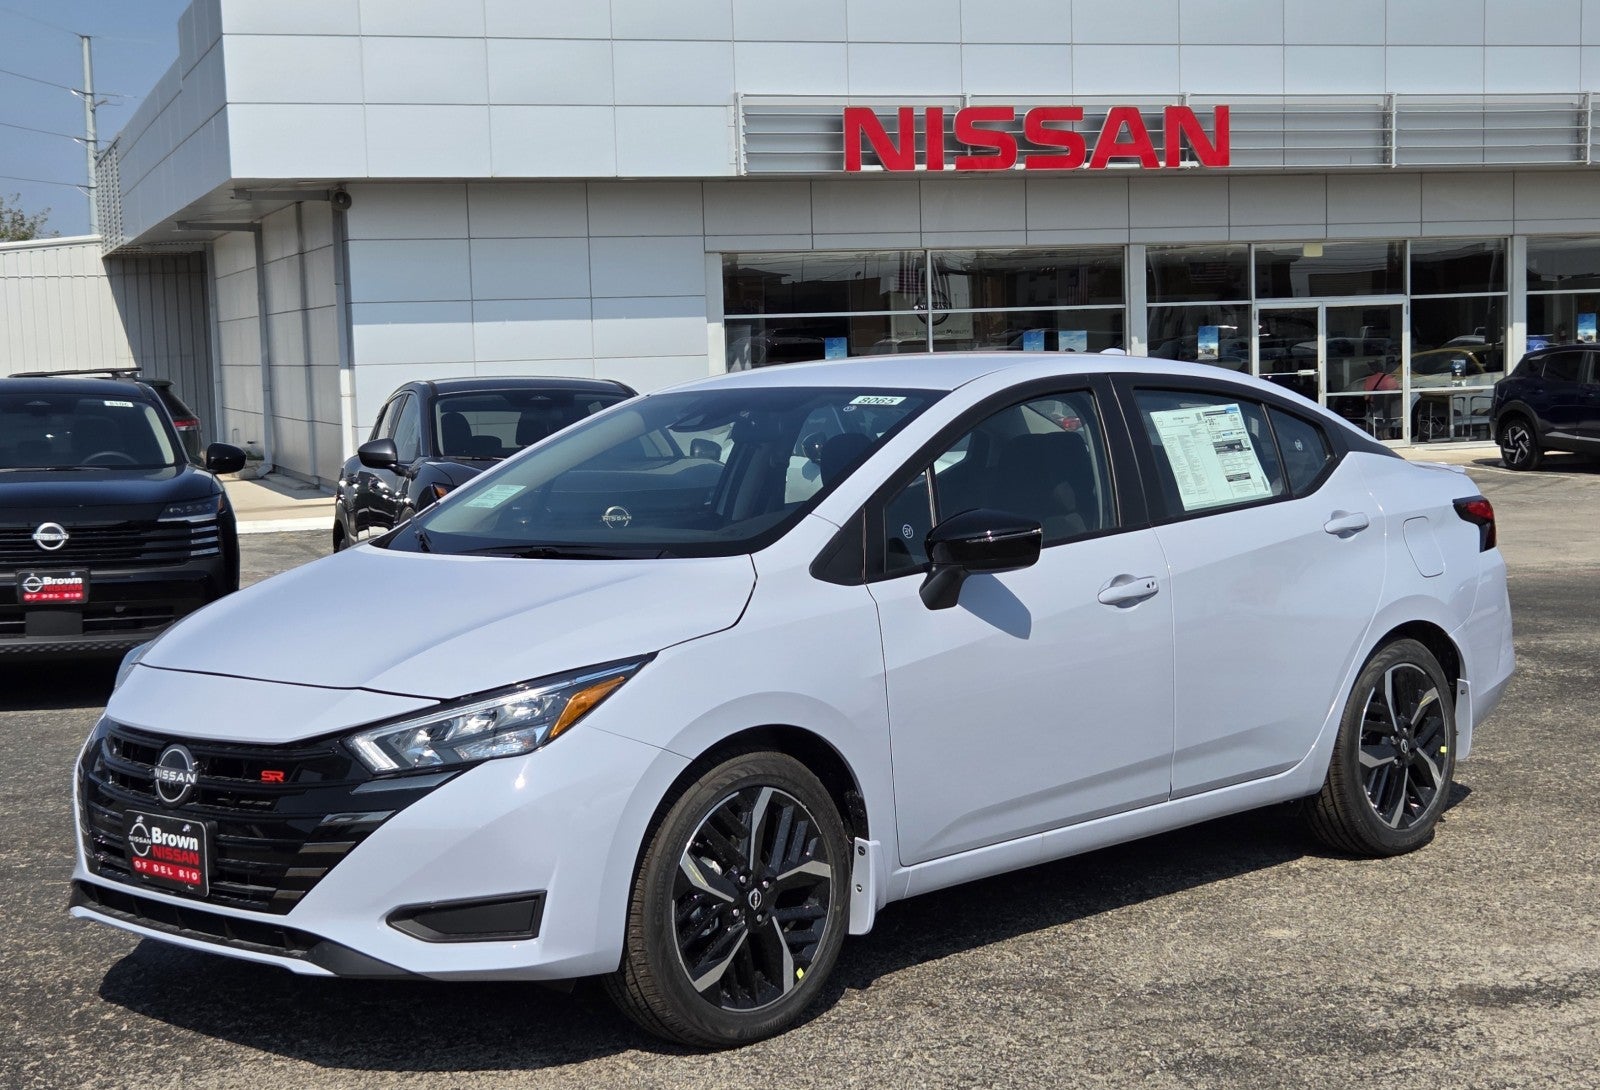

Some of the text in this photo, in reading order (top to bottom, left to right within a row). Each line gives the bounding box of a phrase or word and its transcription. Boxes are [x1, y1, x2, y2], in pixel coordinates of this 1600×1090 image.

[843, 104, 1230, 172] NISSAN
[42, 577, 83, 585] Brown
[154, 768, 196, 784] NISSAN
[261, 770, 284, 783] SR
[128, 835, 152, 846] NISSAN
[151, 826, 199, 851] Brown
[151, 845, 199, 866] NISSAN
[134, 860, 198, 881] OF DEL RIO
